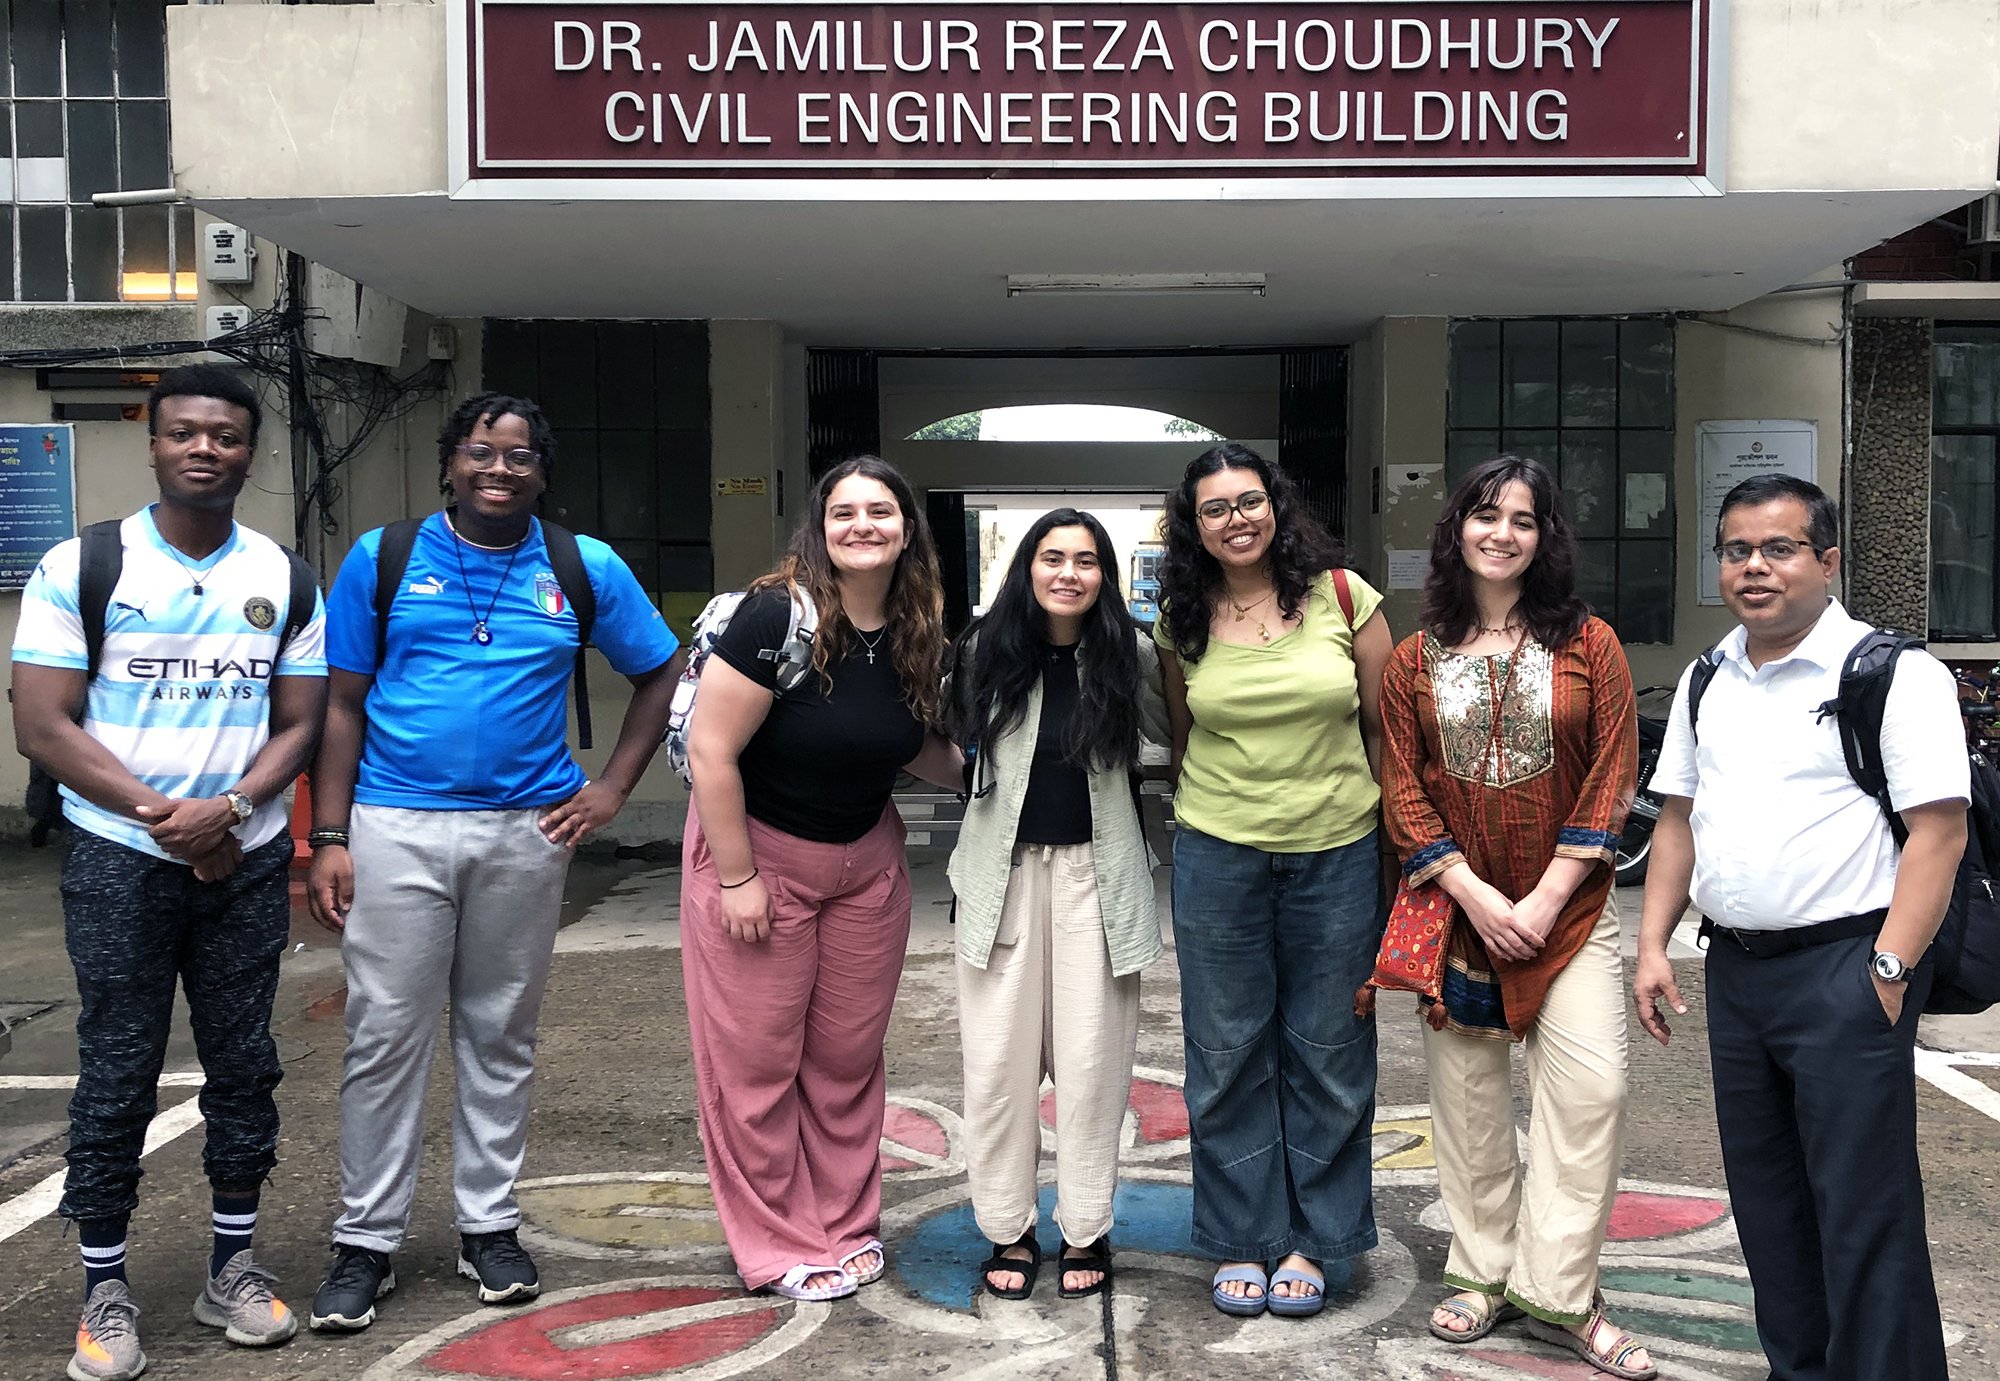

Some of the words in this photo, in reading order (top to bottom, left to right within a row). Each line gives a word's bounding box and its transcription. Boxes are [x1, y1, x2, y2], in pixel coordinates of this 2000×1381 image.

[554, 20, 662, 72] DR.
[687, 20, 981, 72] JAMILUR
[1005, 19, 1175, 71] REZA
[1199, 17, 1620, 72] CHOUDHURY
[605, 90, 772, 143] CIVIL
[797, 90, 1238, 143] ENGINEERING
[1264, 88, 1568, 142] BUILDING
[127, 657, 273, 680] ETIHAD
[151, 686, 252, 700] AIRWAYS
